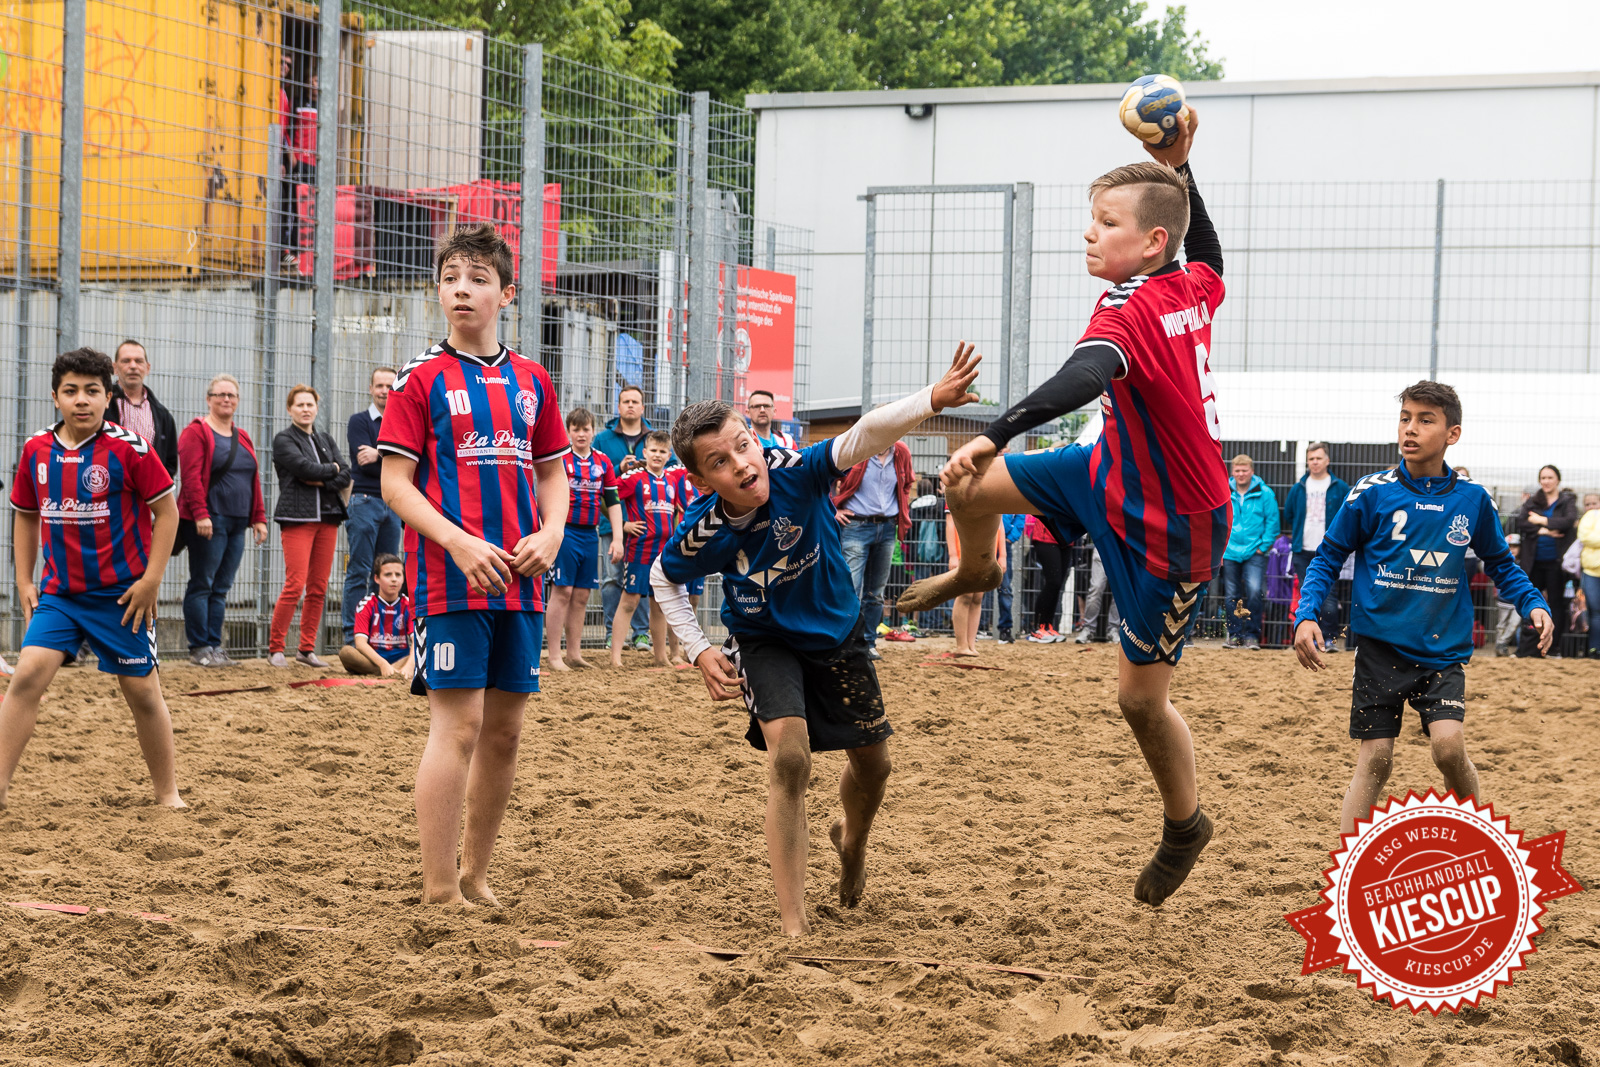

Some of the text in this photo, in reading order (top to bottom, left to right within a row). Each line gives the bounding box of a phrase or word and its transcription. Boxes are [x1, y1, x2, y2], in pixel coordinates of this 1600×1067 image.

[475, 374, 510, 385] hummel
[445, 389, 472, 416] 10
[458, 431, 489, 449] La
[56, 454, 85, 463] hummel
[37, 462, 48, 485] 9
[643, 483, 651, 495] 2
[41, 497, 109, 512] La Piazza
[1416, 501, 1444, 512] hummel
[1391, 509, 1408, 541] 2
[629, 574, 637, 586] 2
[1120, 618, 1155, 653] hummel
[118, 655, 148, 665] hummel
[433, 642, 455, 671] 10
